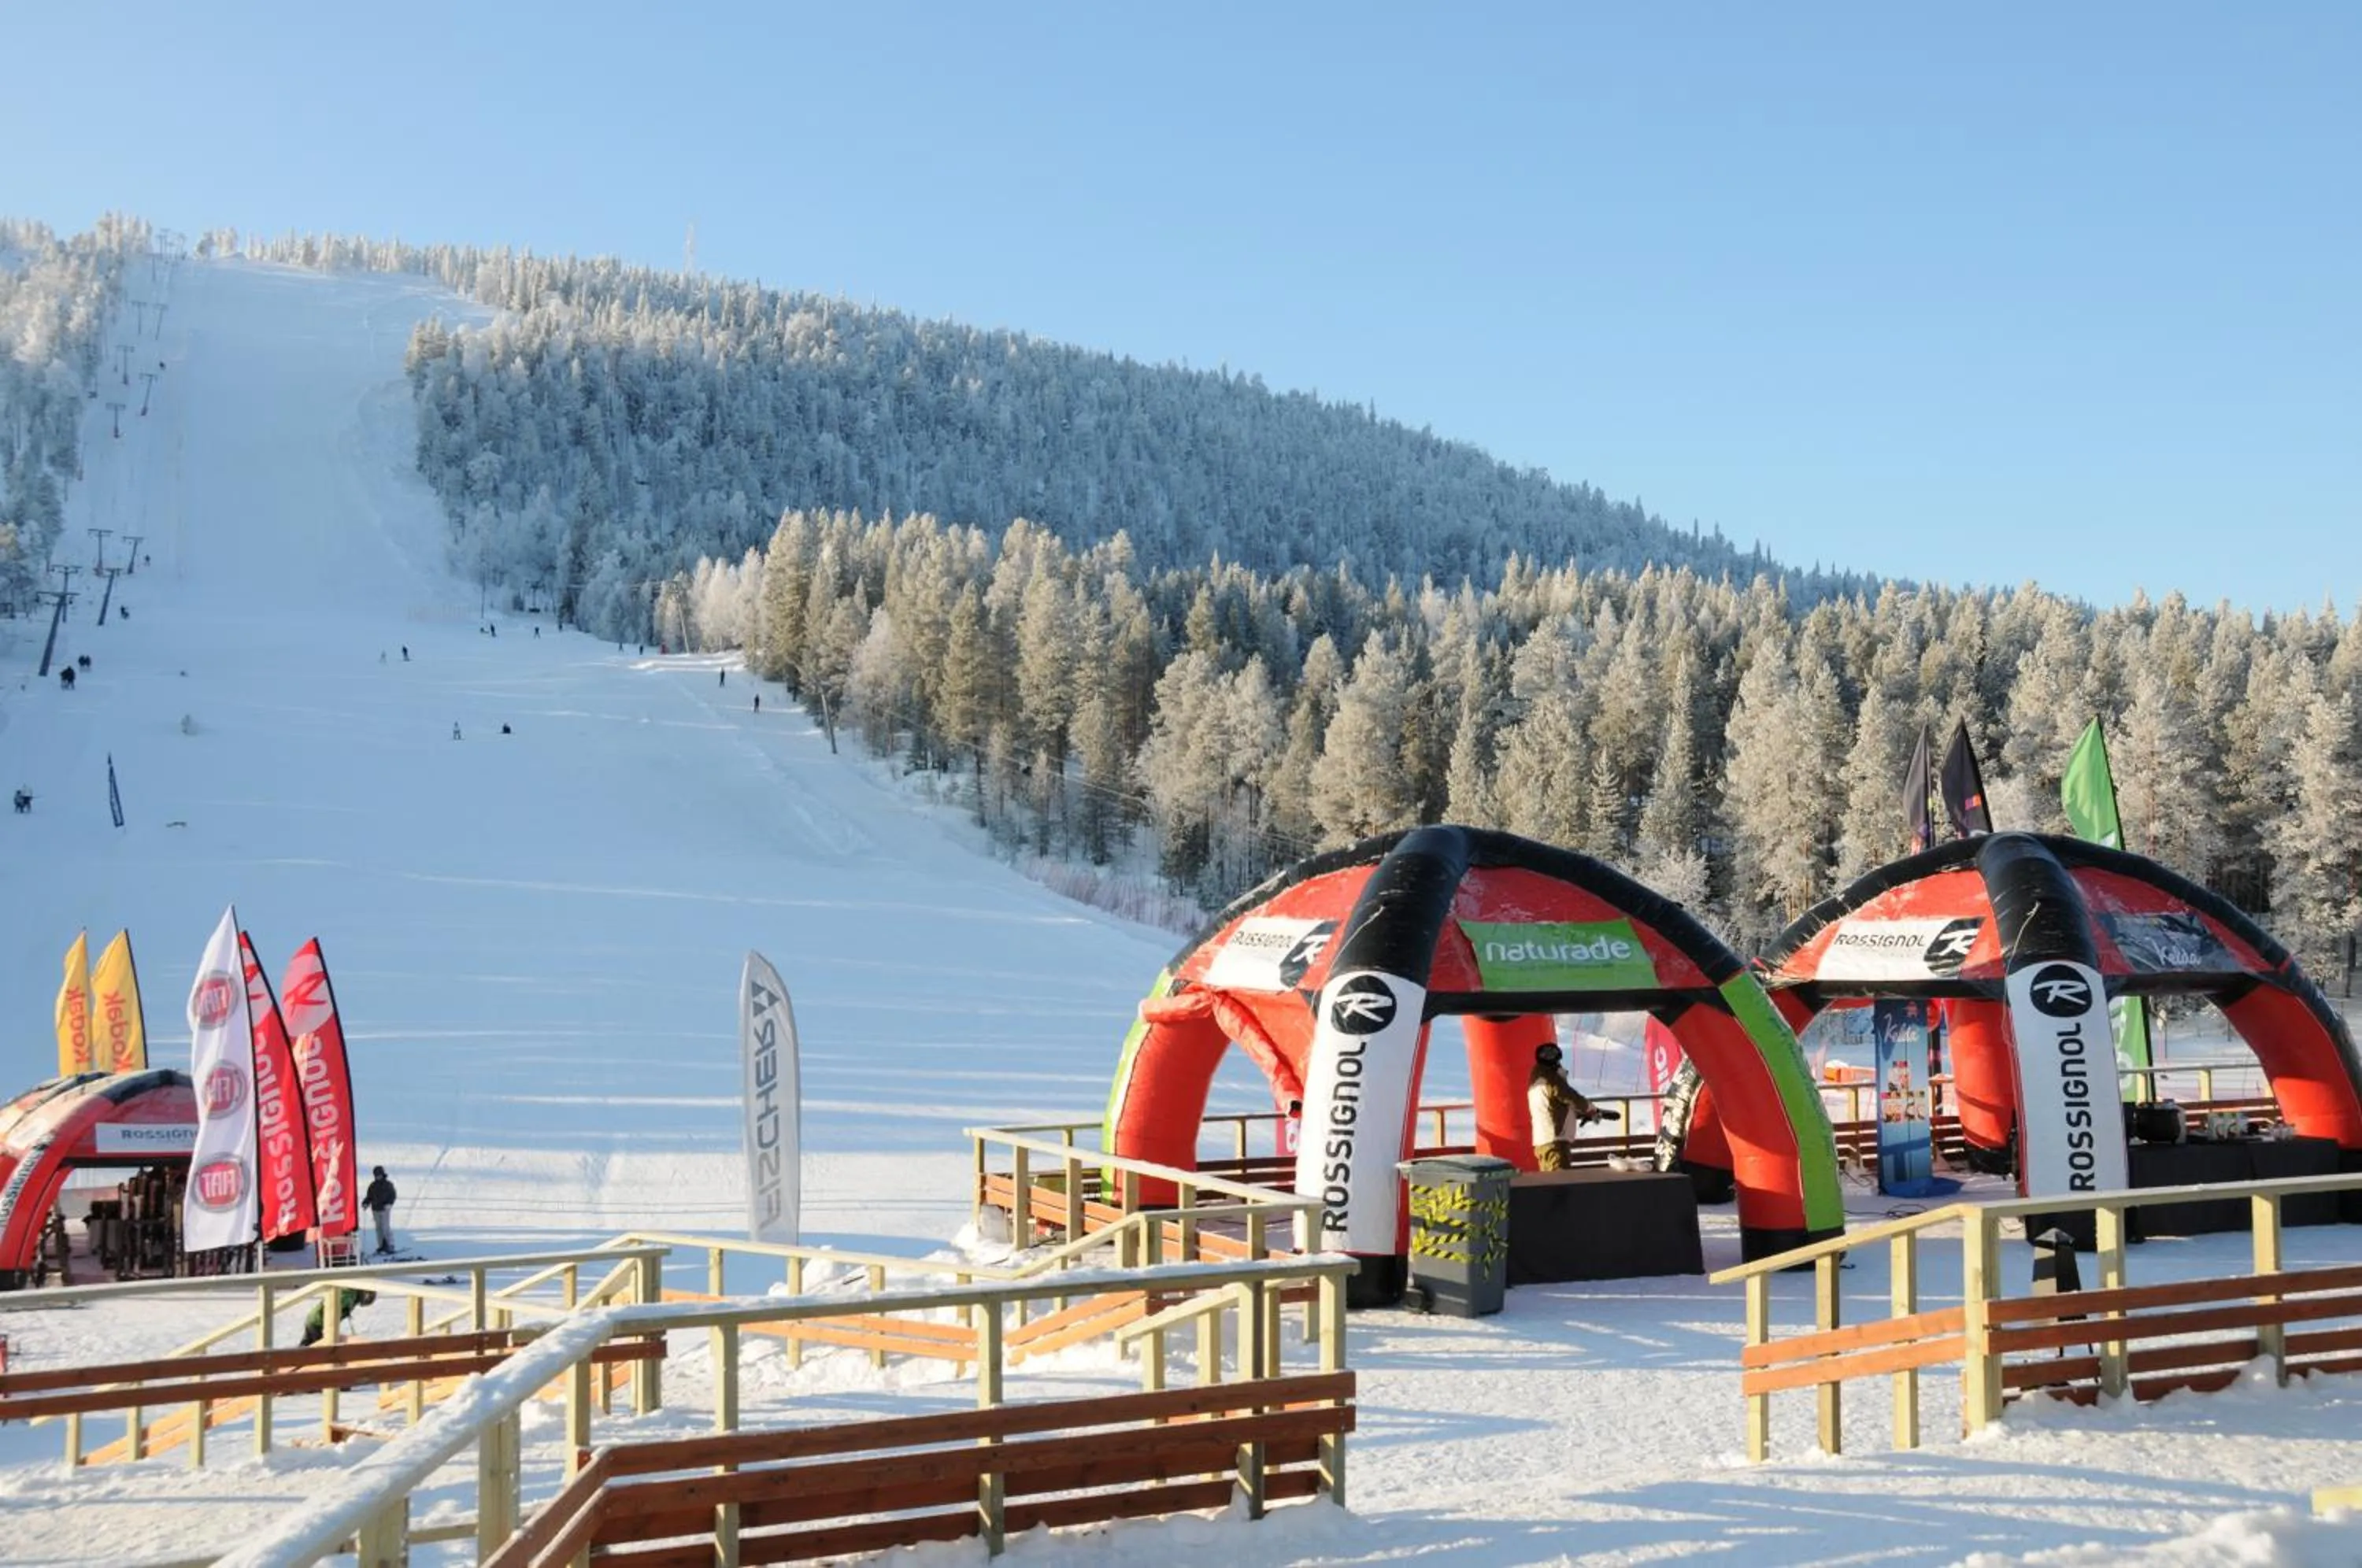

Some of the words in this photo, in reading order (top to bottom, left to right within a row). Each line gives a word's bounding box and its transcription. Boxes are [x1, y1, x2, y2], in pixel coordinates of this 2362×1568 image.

[1485, 934, 1631, 963] naturade
[1834, 934, 1925, 948] ROSSIGNOL
[2057, 1023, 2096, 1192] ROSSIGNOL
[120, 1129, 198, 1141] ROSSIGN
[1322, 1041, 1367, 1233] ROSSIGNOL
